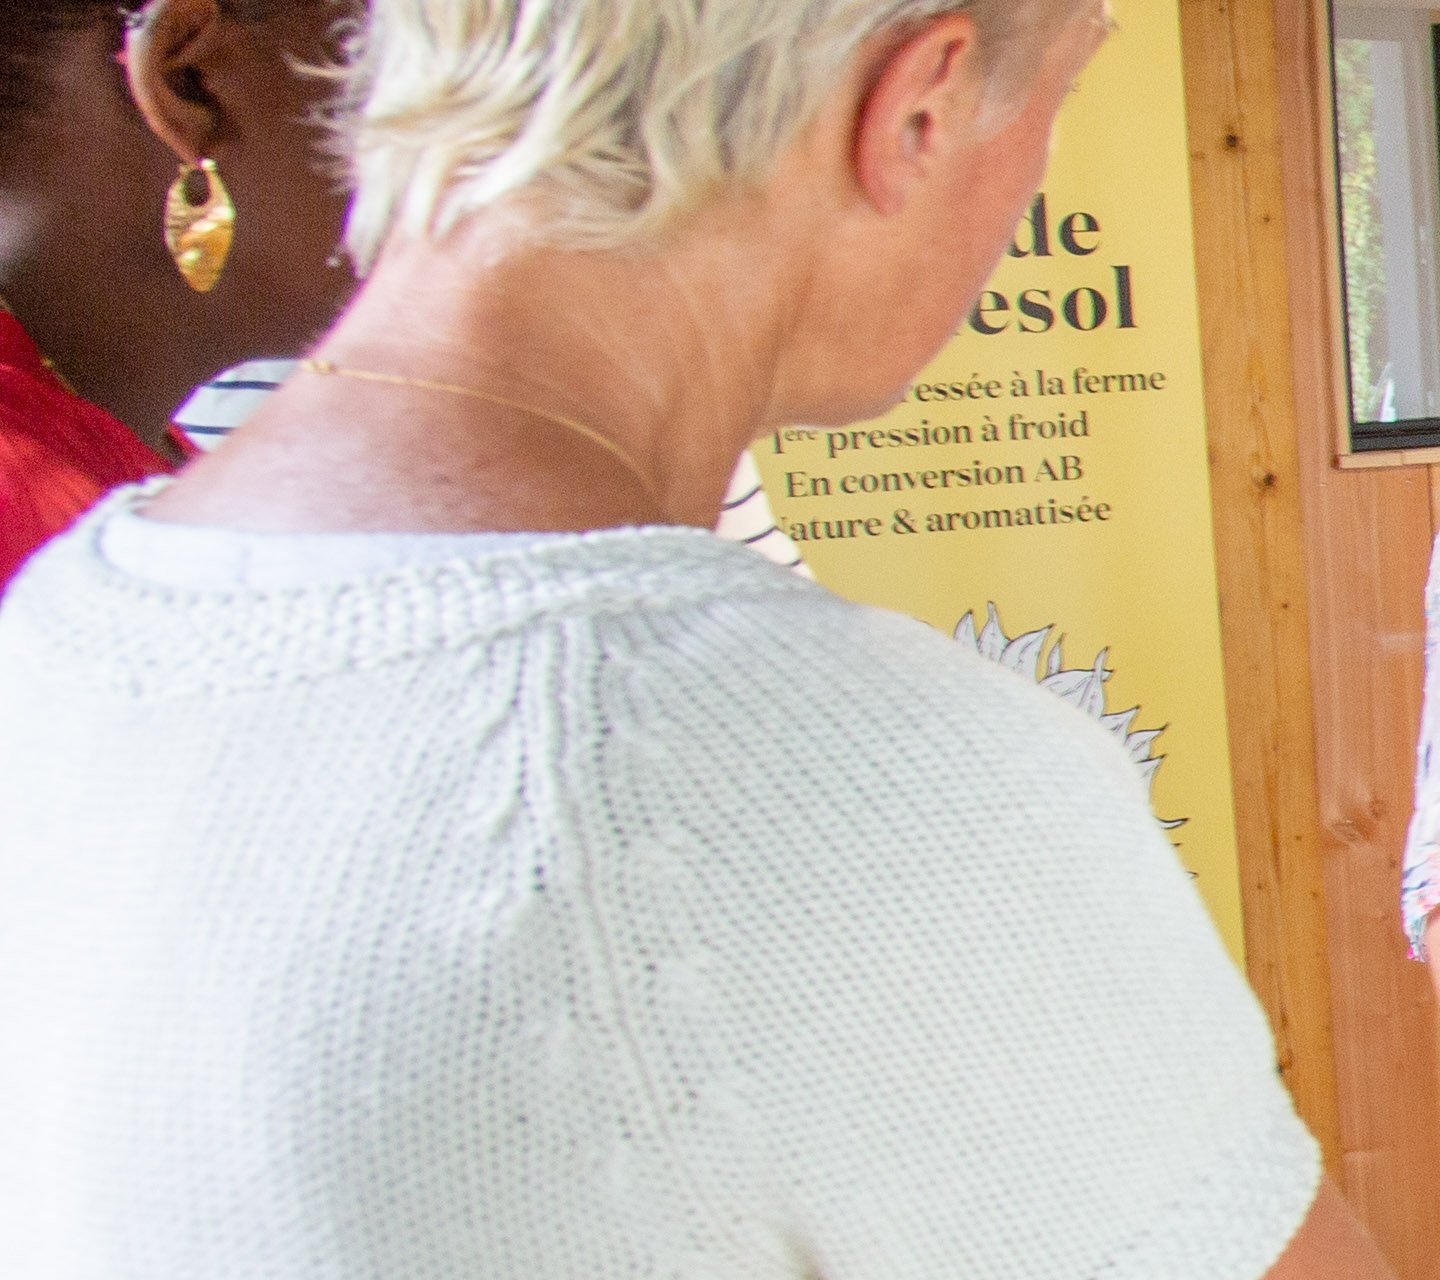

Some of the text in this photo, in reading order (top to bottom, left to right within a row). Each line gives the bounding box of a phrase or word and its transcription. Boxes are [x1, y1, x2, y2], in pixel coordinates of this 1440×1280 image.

[1007, 191, 1101, 258] de
[960, 265, 1139, 336] esol
[1010, 371, 1029, 398] à
[1036, 369, 1067, 396] la
[1073, 367, 1167, 394] ferme
[826, 416, 972, 459] pression
[981, 416, 999, 441] à
[1008, 411, 1090, 440] froid
[785, 454, 1085, 498] En conversion AB
[891, 509, 918, 535] &
[926, 496, 1112, 533] aromatisée
